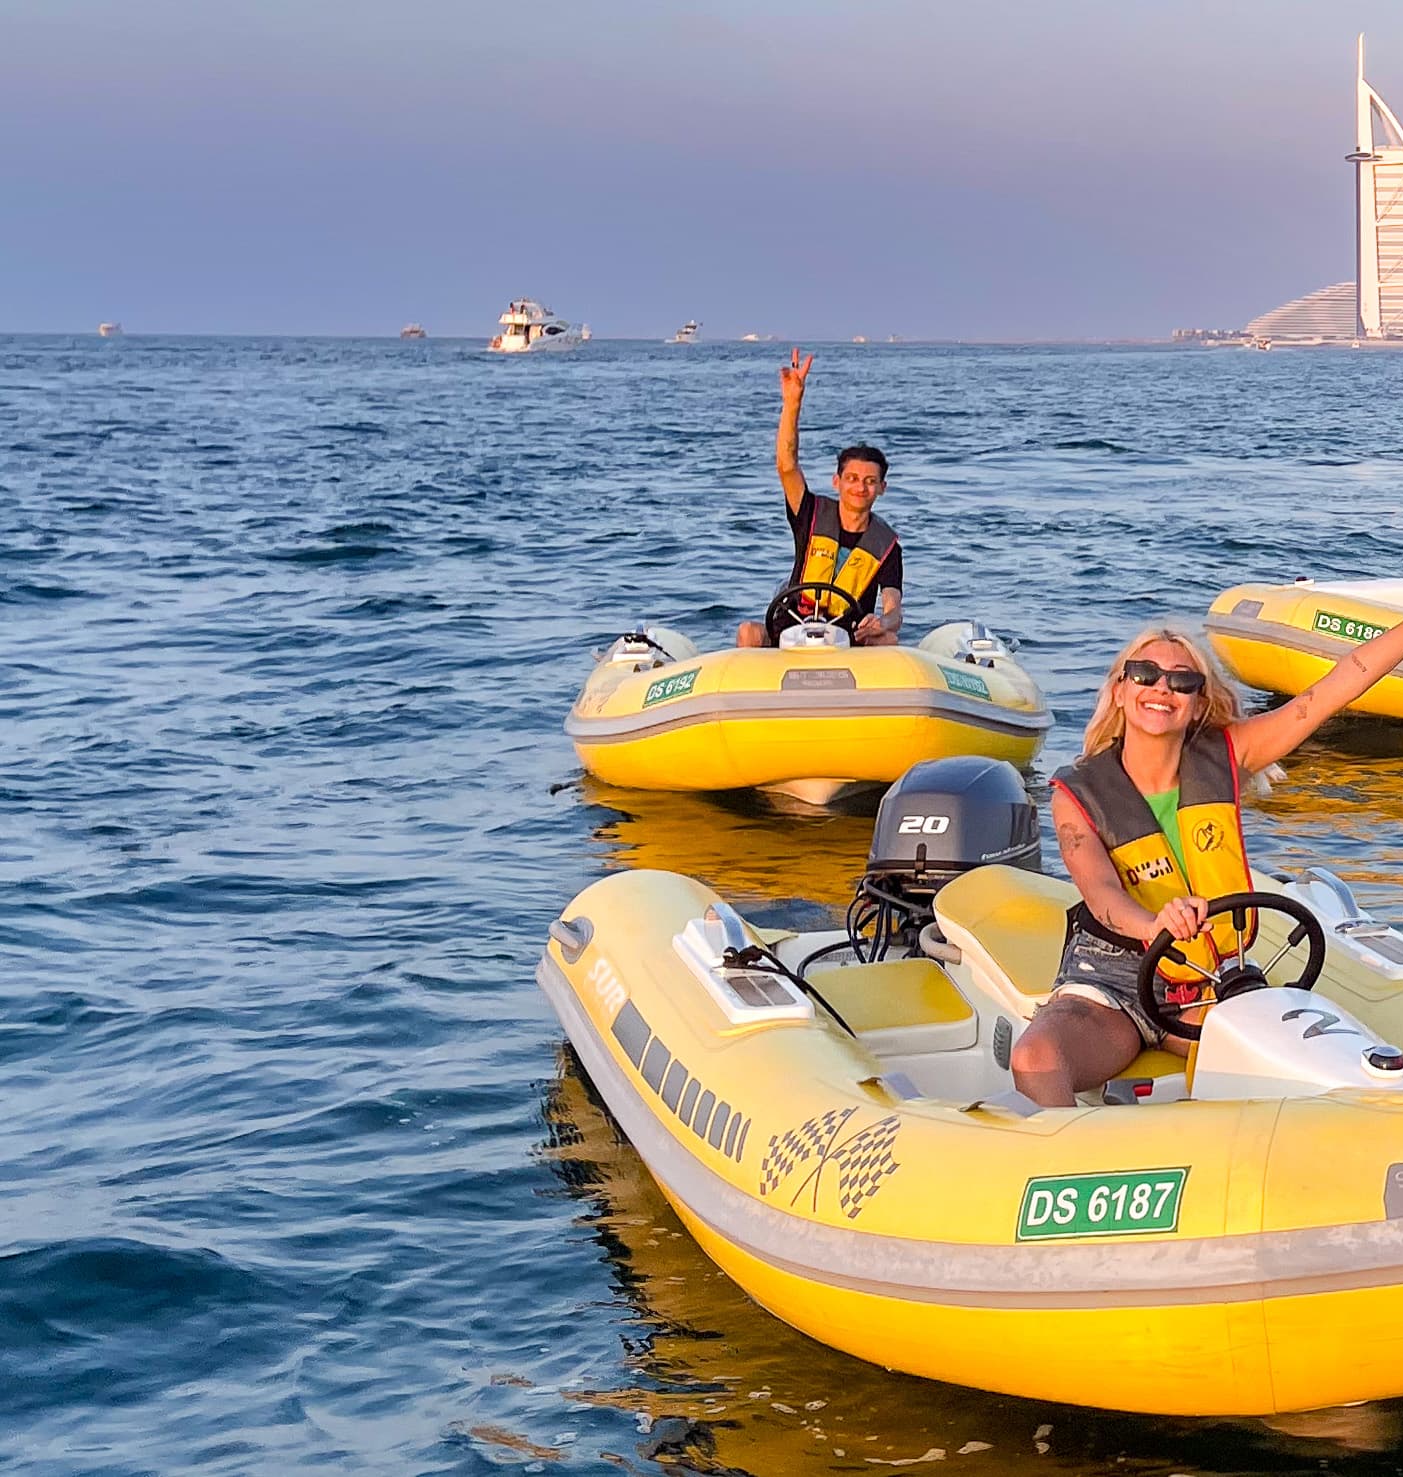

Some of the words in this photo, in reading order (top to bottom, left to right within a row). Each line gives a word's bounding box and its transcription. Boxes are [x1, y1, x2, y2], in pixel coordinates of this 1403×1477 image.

[1317, 614, 1342, 631] DS
[647, 682, 665, 701] DS
[898, 815, 950, 834] 20
[587, 957, 626, 1014] SUR
[1026, 1187, 1079, 1226] DS
[1087, 1181, 1176, 1223] 6187
